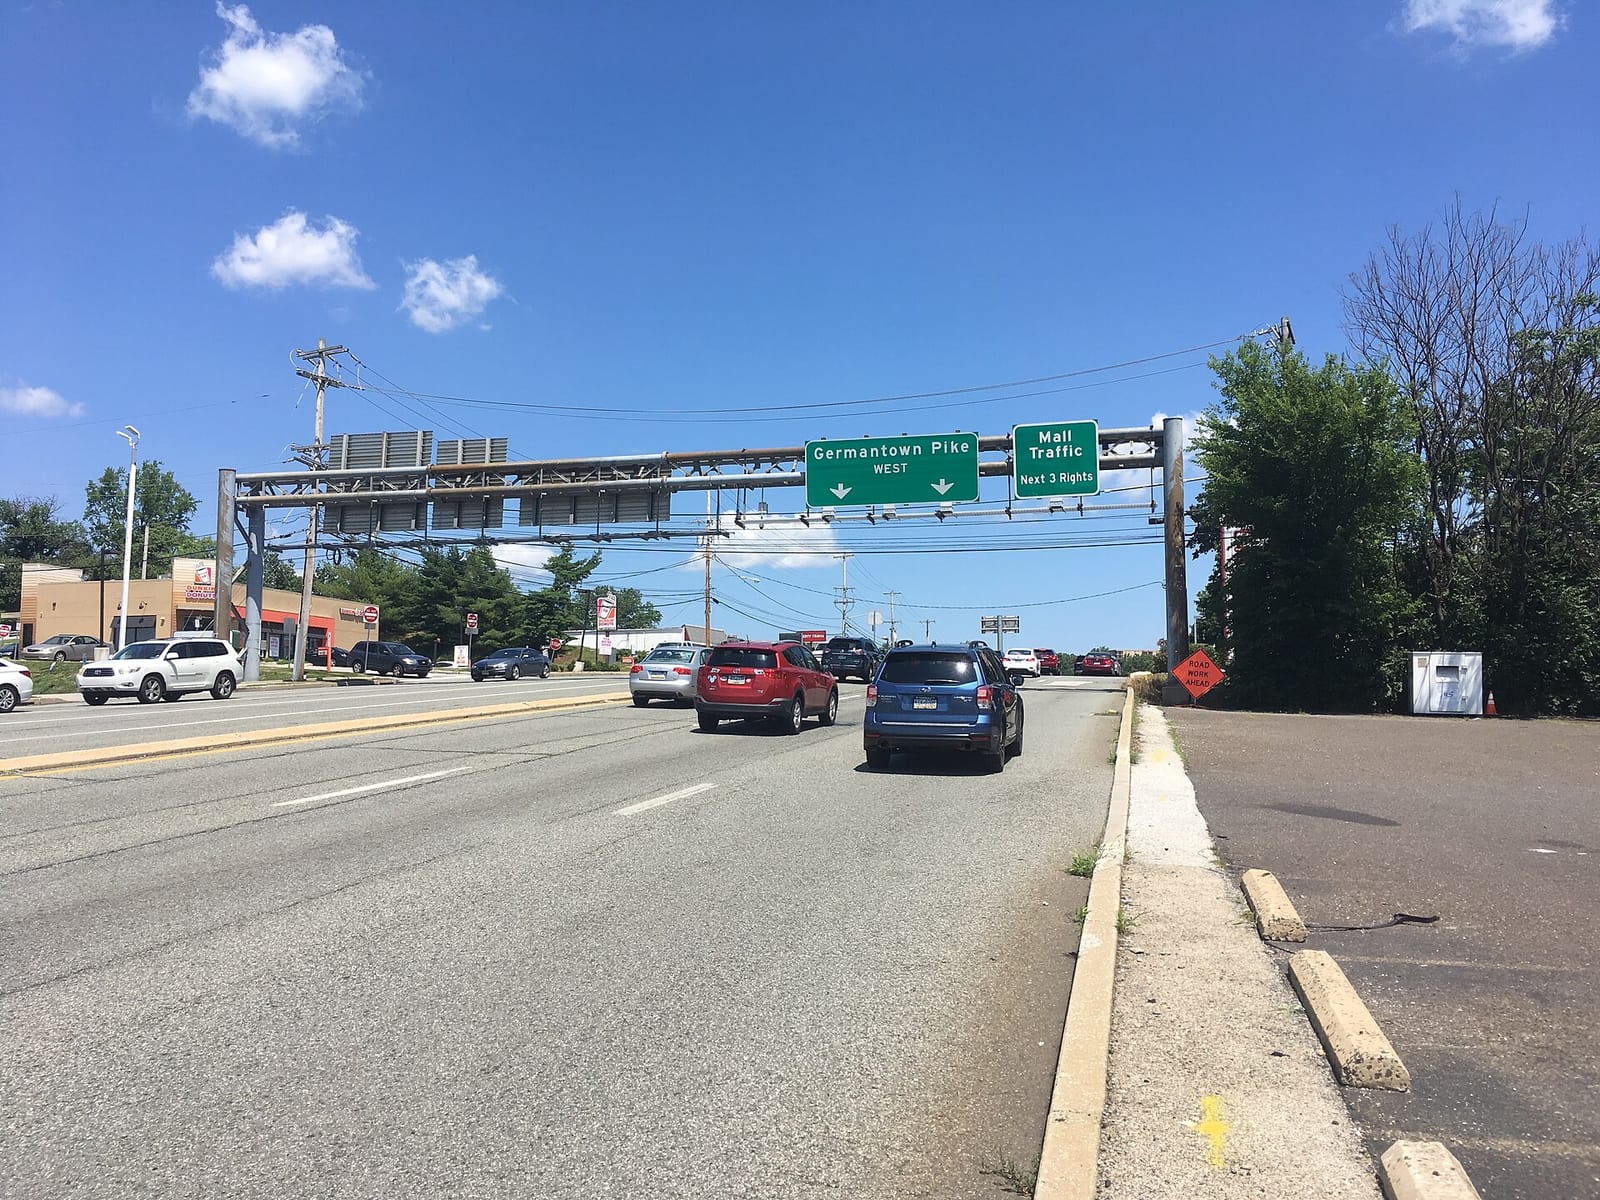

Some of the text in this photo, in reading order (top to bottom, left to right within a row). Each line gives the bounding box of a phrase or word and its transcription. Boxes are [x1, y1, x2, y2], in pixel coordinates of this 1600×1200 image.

[1039, 430, 1072, 443] Mall
[813, 441, 969, 460] Germantown Pike
[1029, 445, 1083, 459] Traffic
[873, 463, 908, 474] WEST
[1020, 472, 1093, 485] Next 3 Rights
[1189, 660, 1210, 669] ROAD
[1187, 670, 1209, 678] WORK
[1185, 679, 1210, 688] AHEAD
